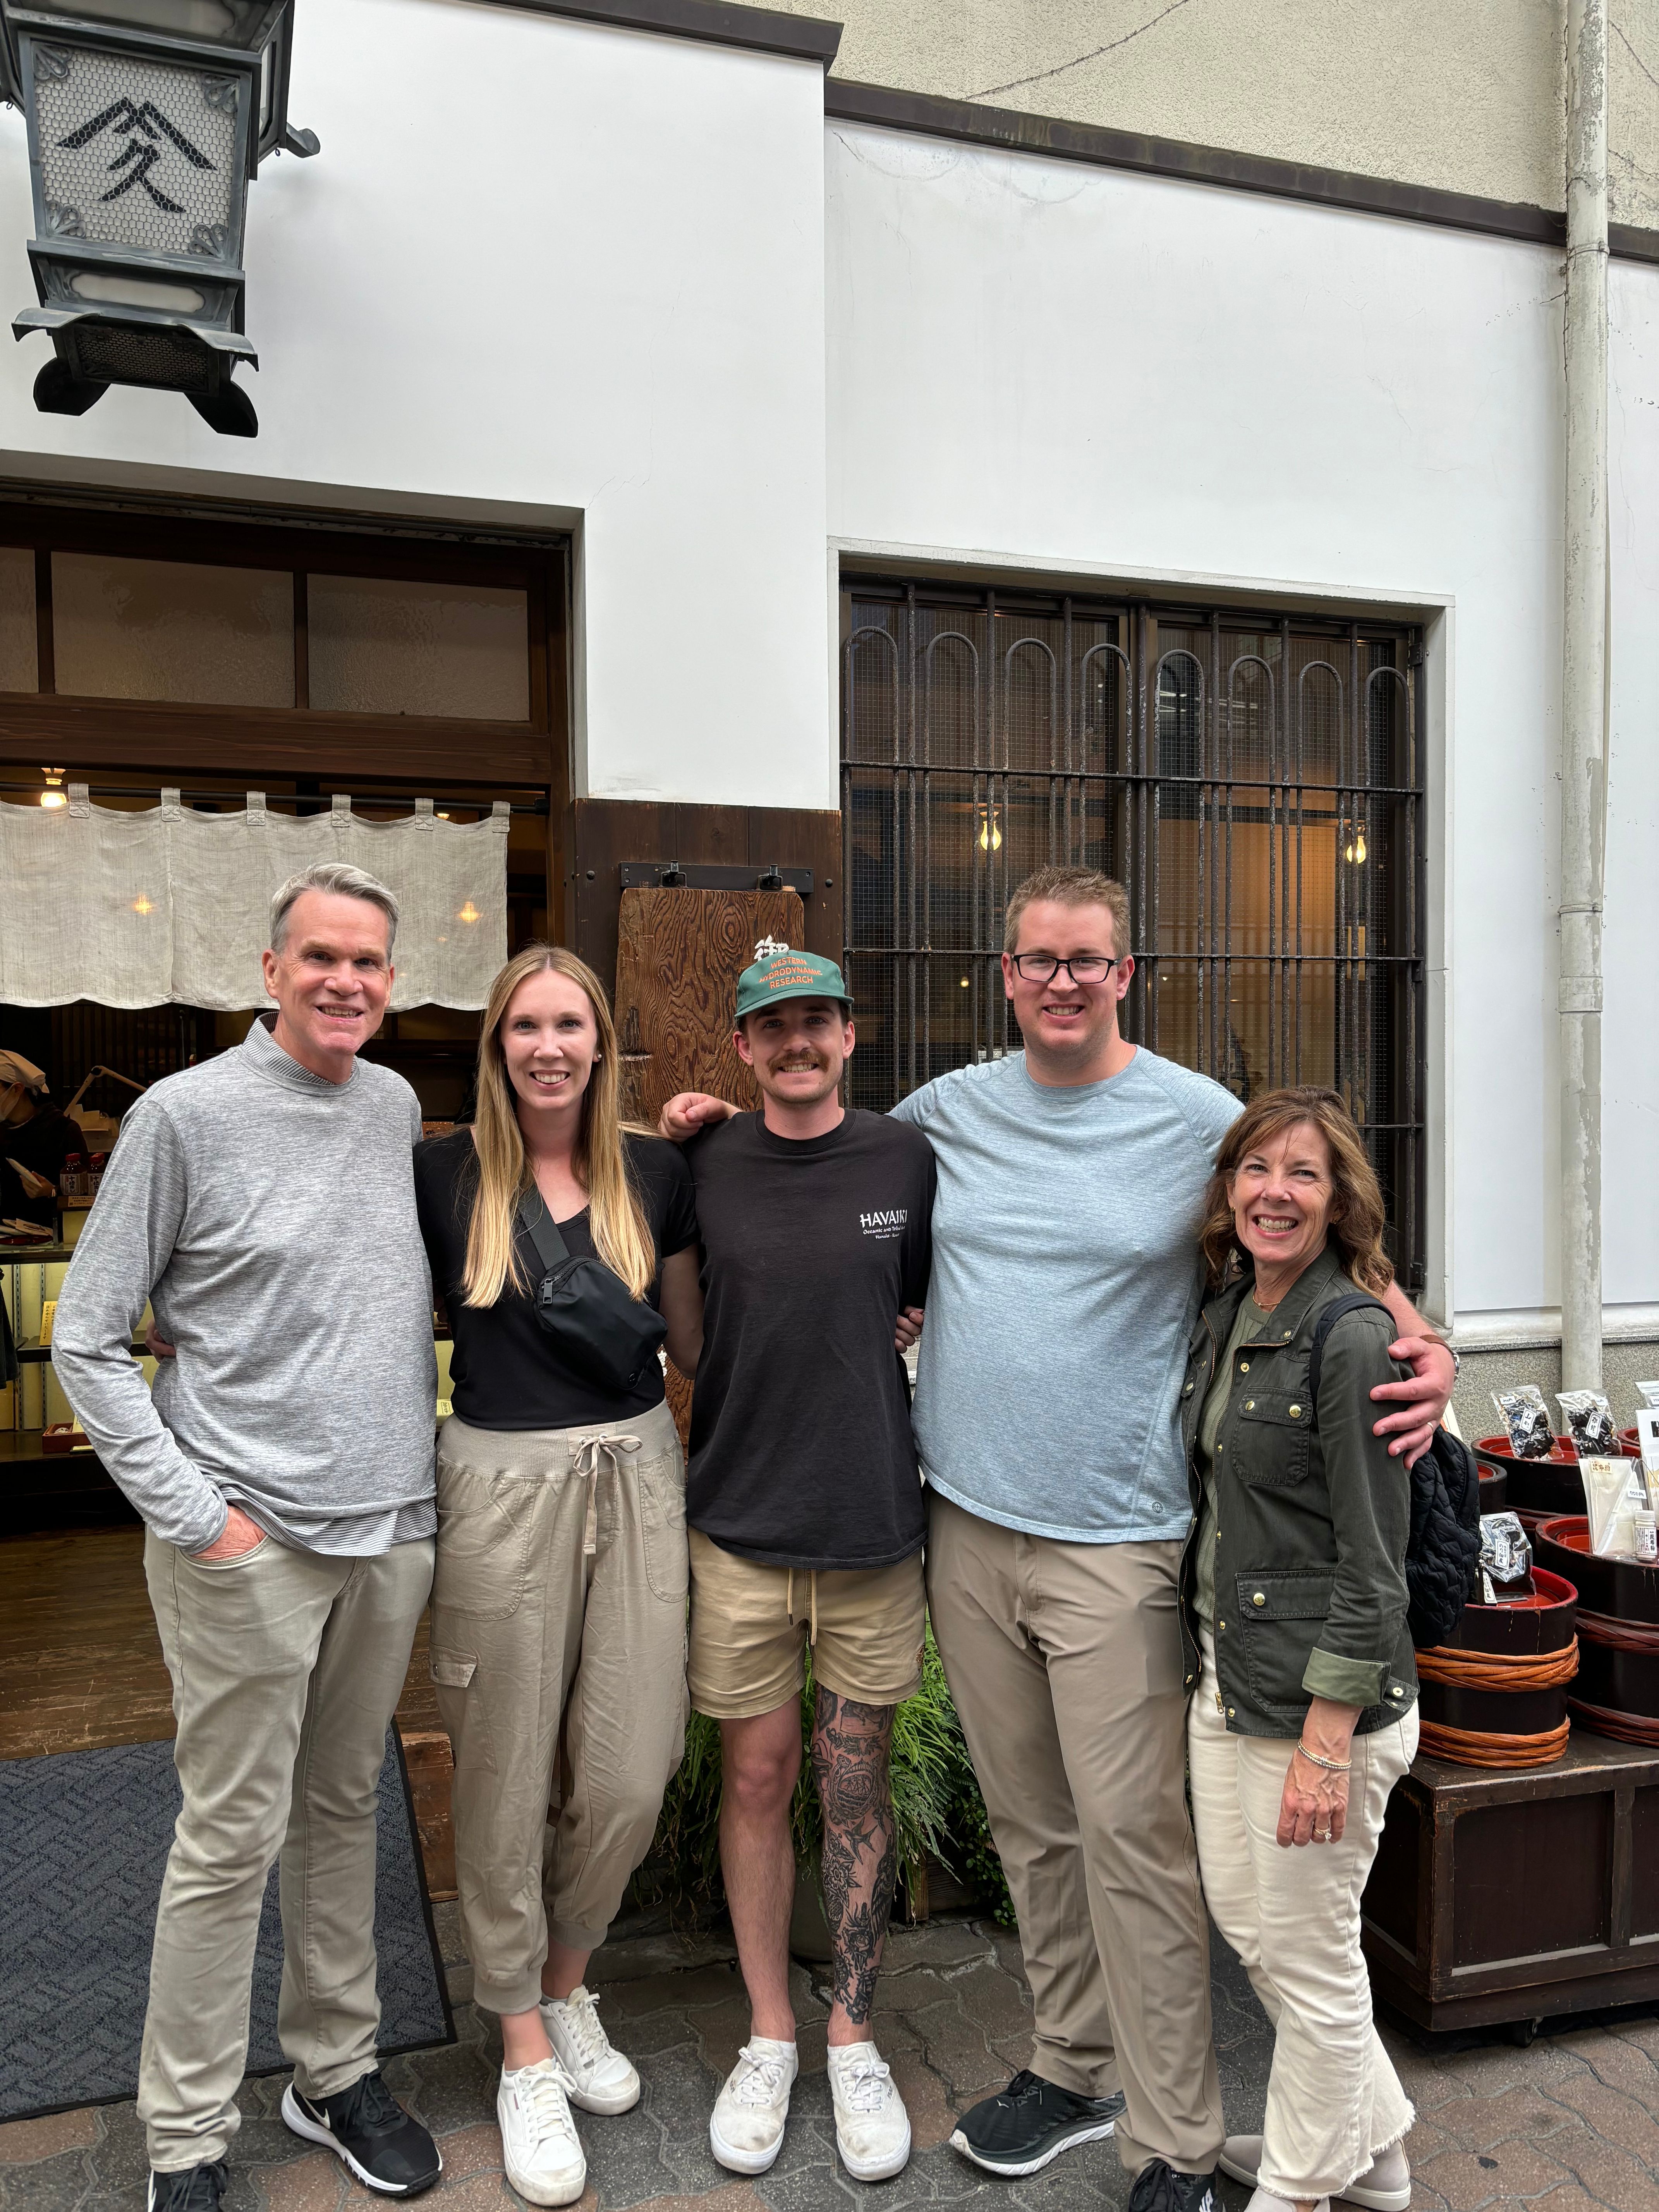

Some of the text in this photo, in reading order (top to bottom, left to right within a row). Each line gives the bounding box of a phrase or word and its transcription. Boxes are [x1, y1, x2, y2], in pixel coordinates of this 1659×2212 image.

[771, 957, 807, 969] WESTERN
[759, 967, 823, 983] HYDRODYNAMIC
[770, 975, 813, 989] RESEARCH
[859, 1209, 907, 1228] HAVAIKI
[1592, 1463, 1610, 1472] 昆布粉
